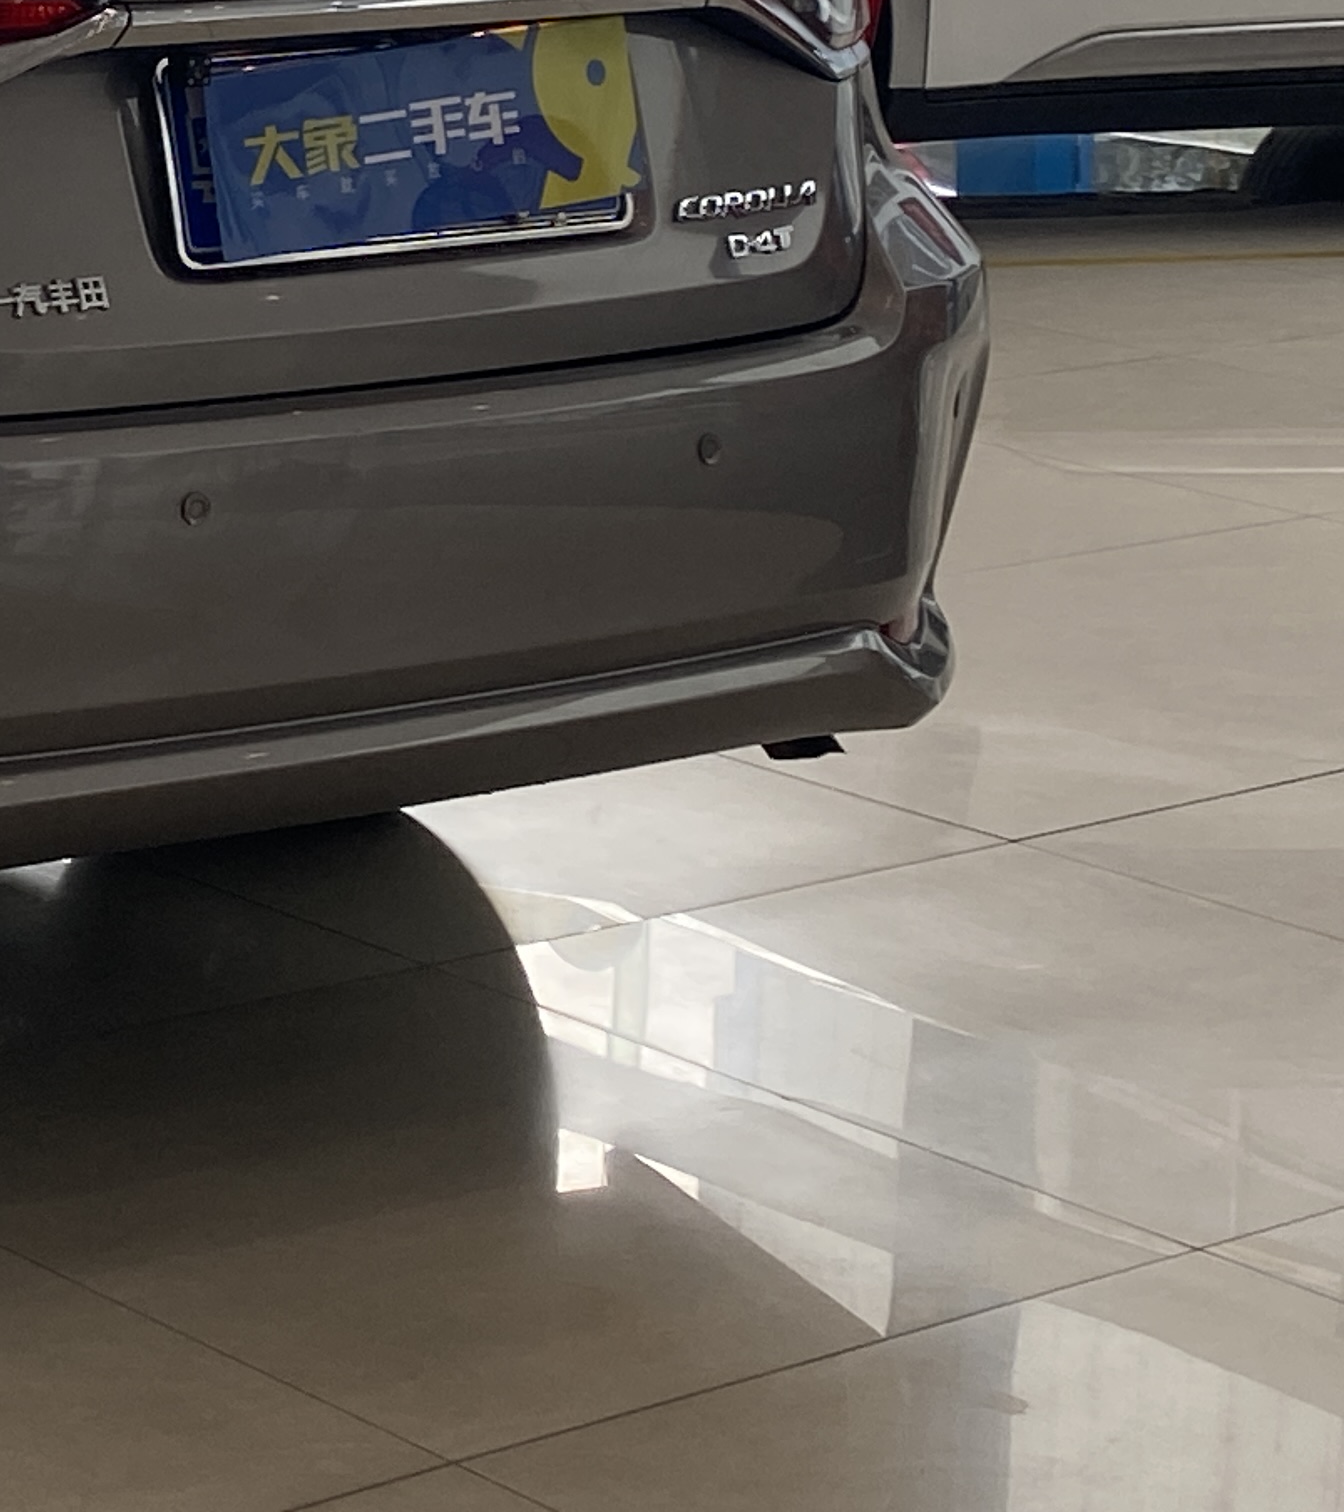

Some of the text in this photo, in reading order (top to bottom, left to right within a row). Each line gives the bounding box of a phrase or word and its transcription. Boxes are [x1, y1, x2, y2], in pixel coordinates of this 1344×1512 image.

[243, 90, 521, 187] 大象二手车
[676, 179, 817, 221] COROLLA
